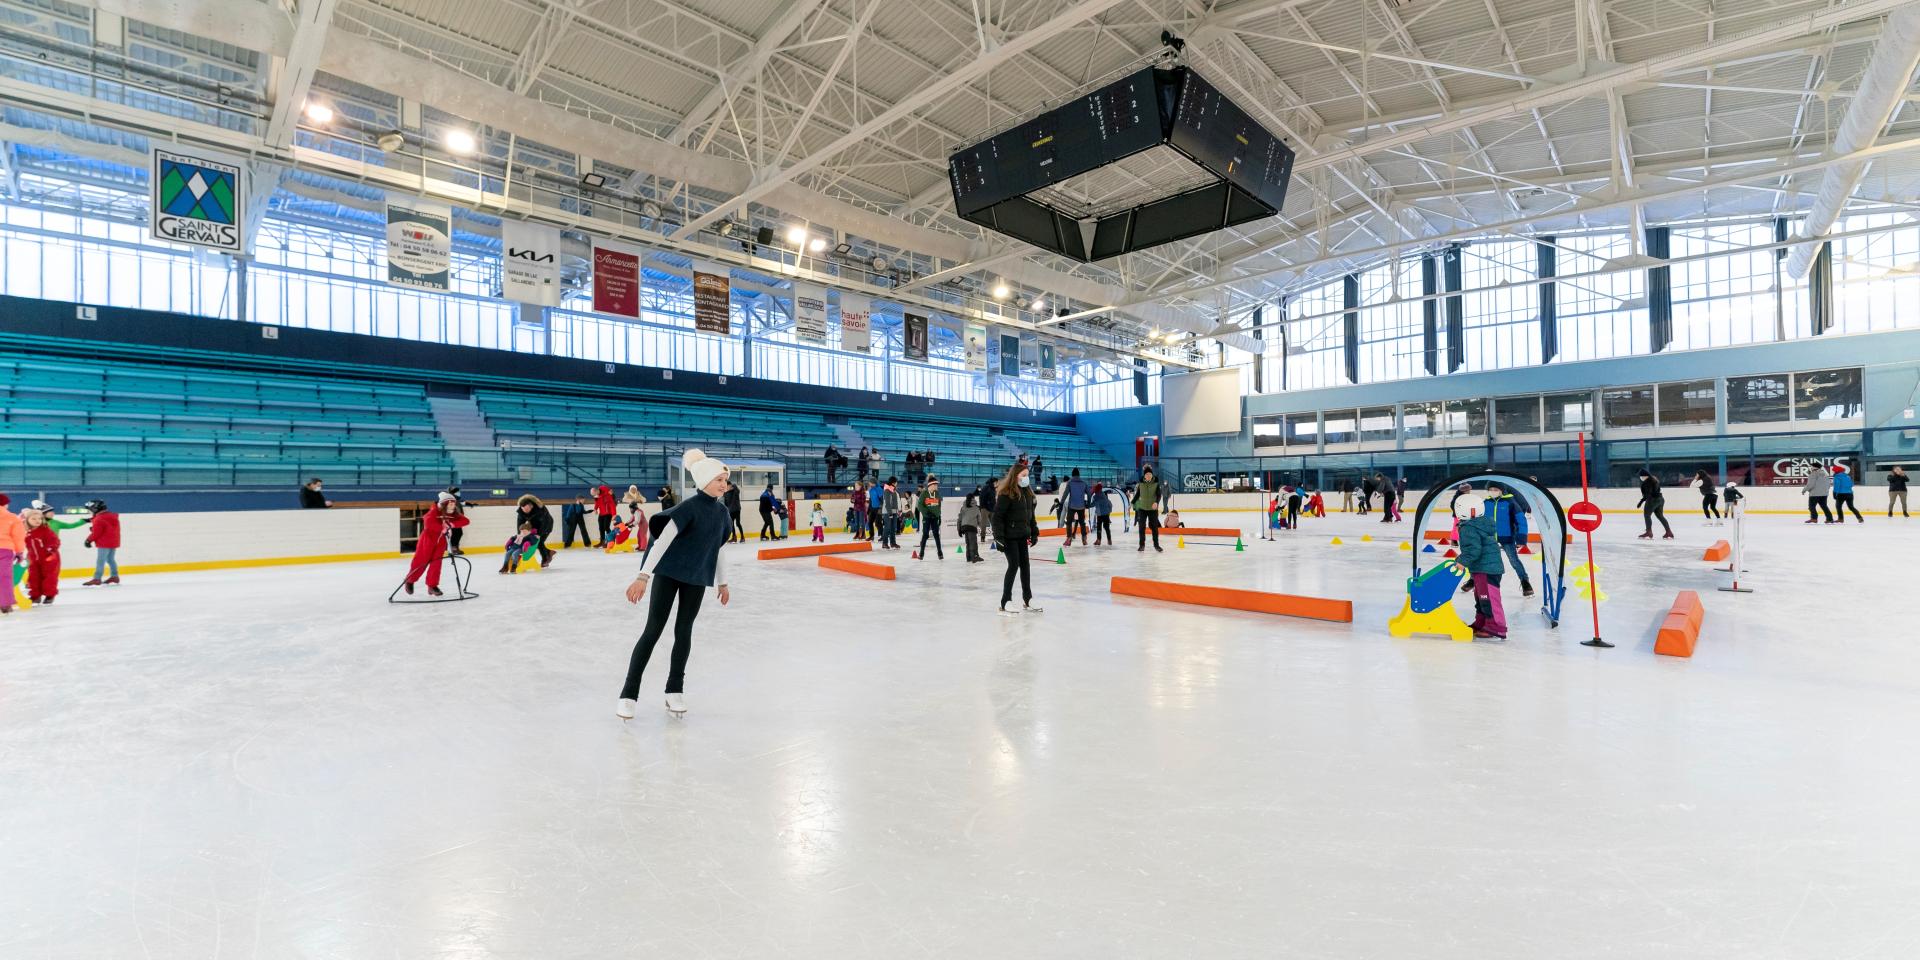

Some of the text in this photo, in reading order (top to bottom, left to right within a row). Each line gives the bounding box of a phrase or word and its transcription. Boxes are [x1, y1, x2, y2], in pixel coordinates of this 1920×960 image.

[159, 217, 236, 245] GERVAIS
[178, 219, 220, 233] SAINT
[402, 230, 433, 240] WOLF
[842, 309, 863, 320] haute
[842, 319, 865, 329] savoie
[1792, 457, 1834, 467] SAINT
[1184, 474, 1216, 487] GERVAIS
